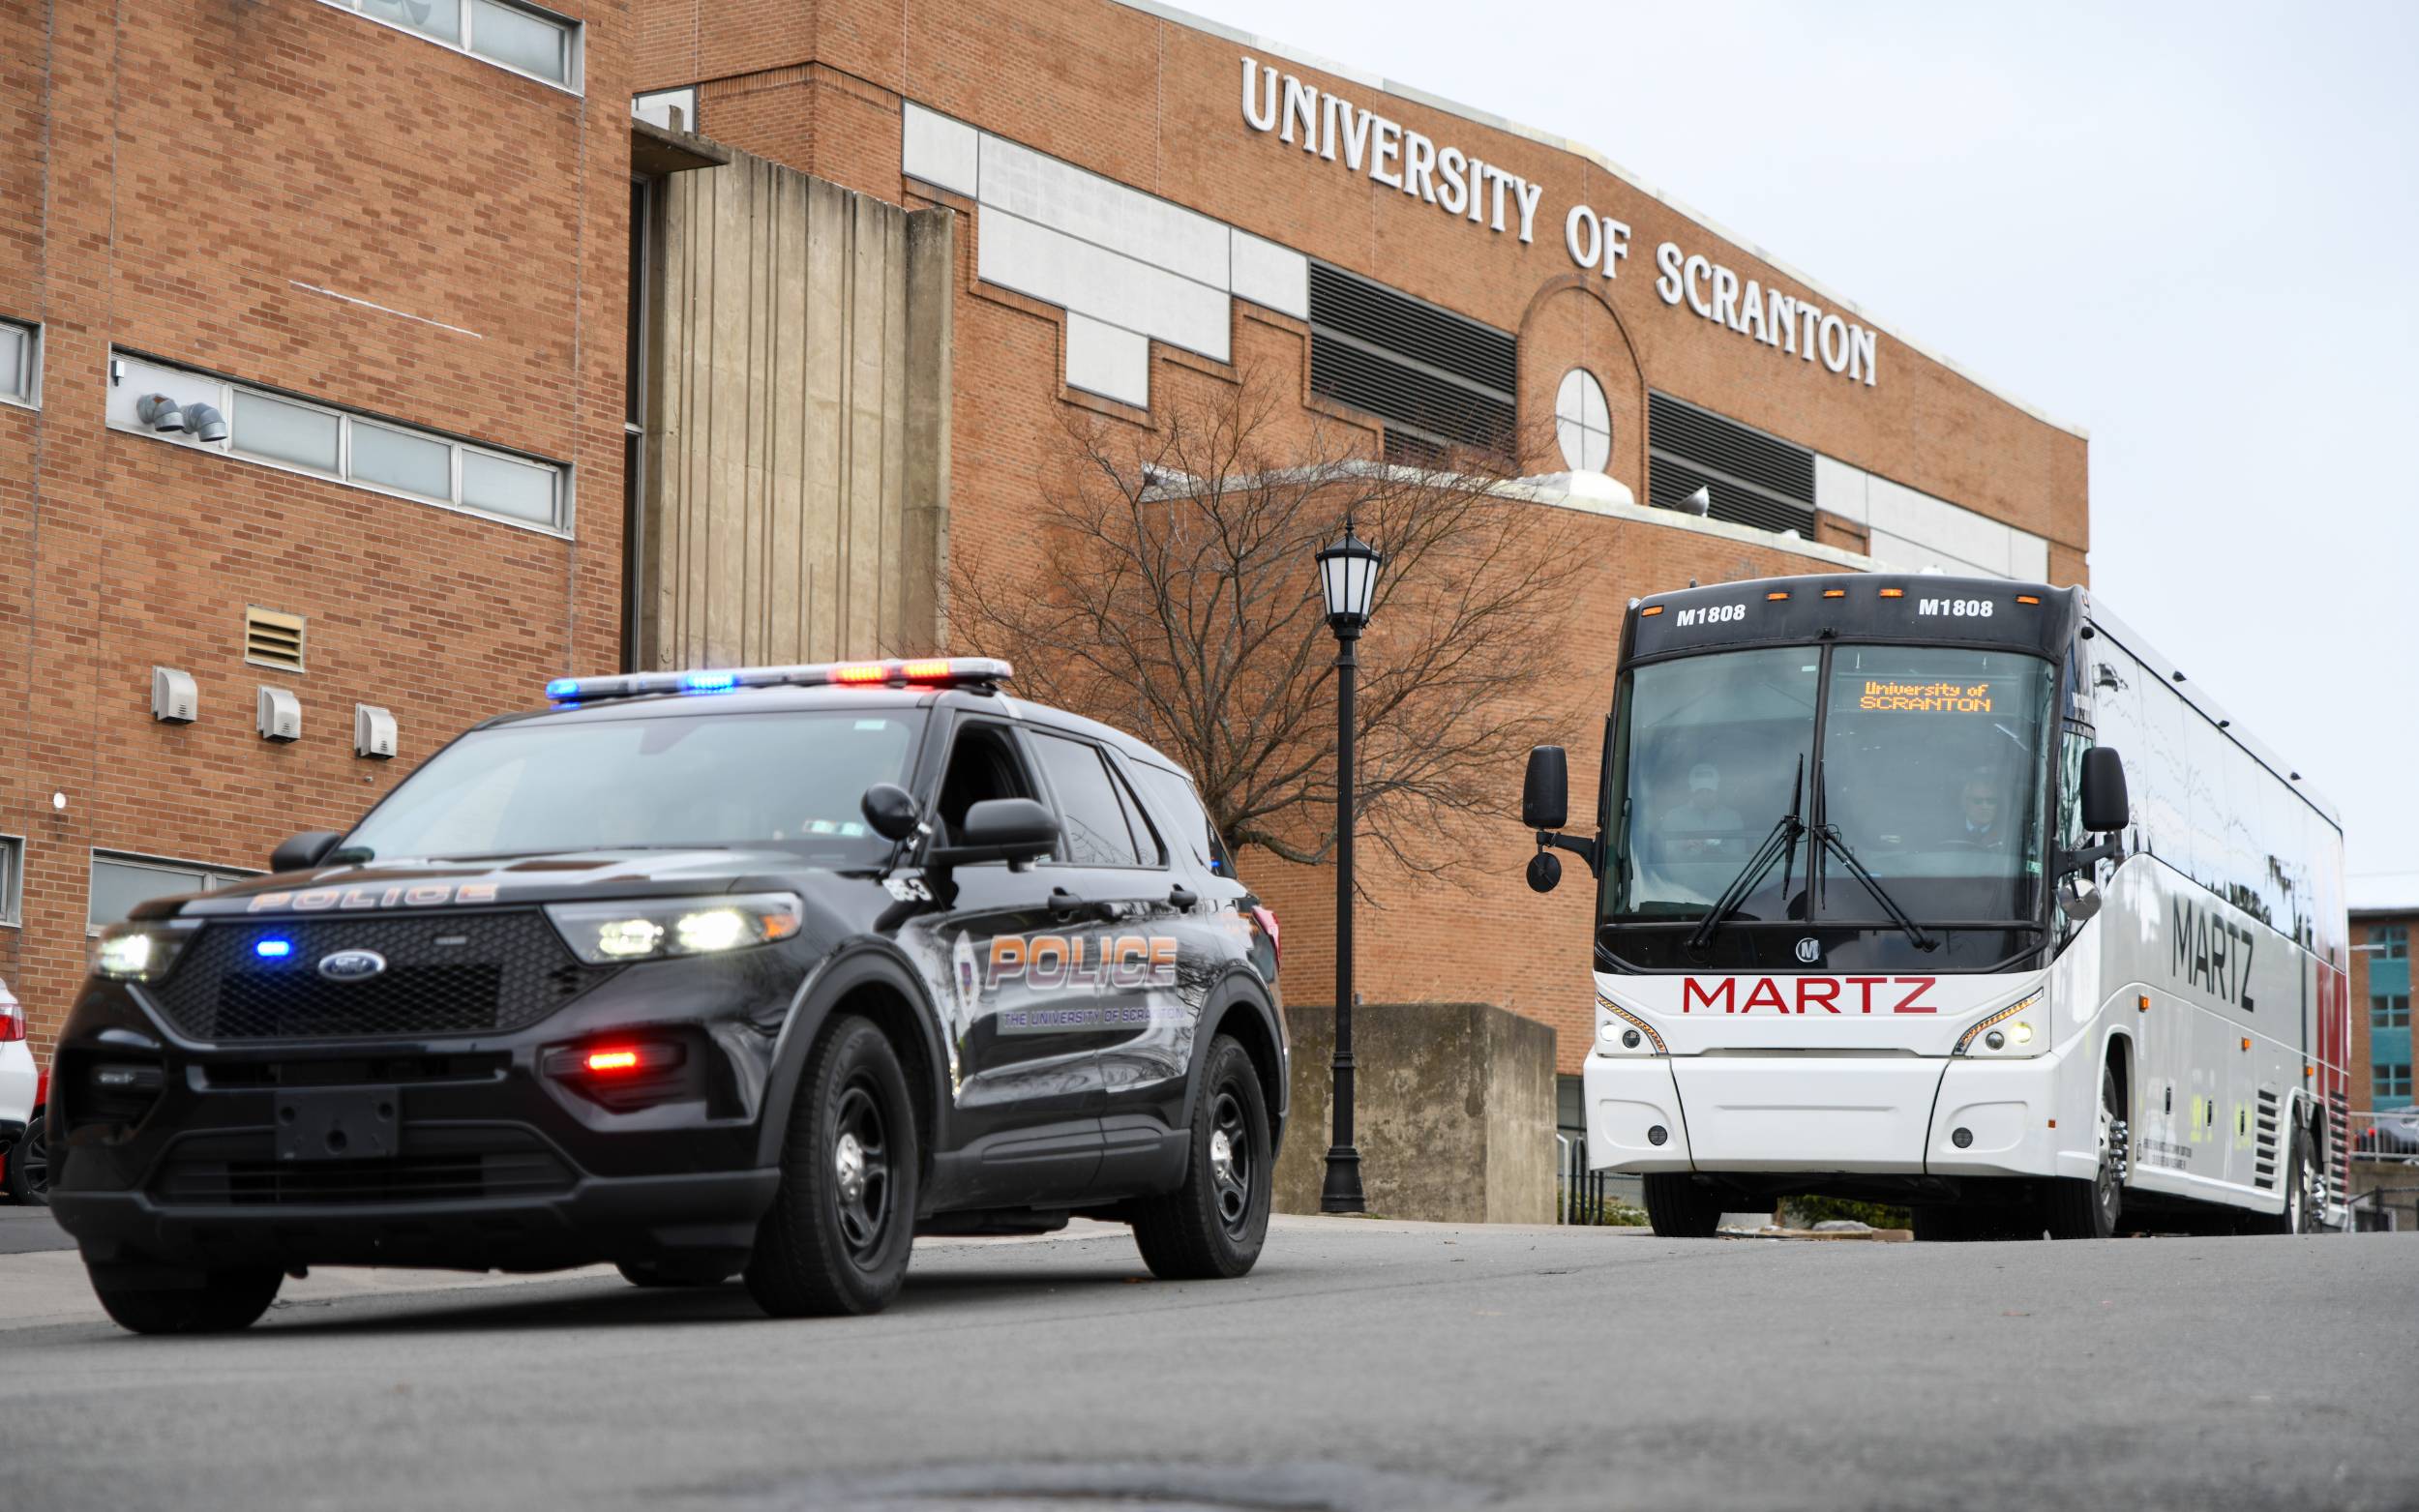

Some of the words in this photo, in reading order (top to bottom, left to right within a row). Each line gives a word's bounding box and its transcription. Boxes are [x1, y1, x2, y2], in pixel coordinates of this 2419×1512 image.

[1240, 56, 1542, 244] UNIVERSITY
[1566, 204, 1631, 280] OF
[1656, 242, 1878, 387] SCRANTON
[1676, 604, 1747, 628] M1808
[1919, 598, 1994, 618] M1808
[1865, 681, 1961, 697] University
[1967, 683, 1989, 697] of
[1860, 696, 1991, 712] SCRANTON
[247, 882, 499, 913] POLICE
[985, 934, 1178, 990] POLICE
[2172, 890, 2255, 1013] MARTZ
[1683, 977, 1938, 1014] MARTZ
[1004, 1012, 1027, 1027] THE
[1030, 1009, 1101, 1026] UNIVERSITY
[1104, 1008, 1120, 1023] OF
[1121, 1006, 1185, 1022] SCRATON
